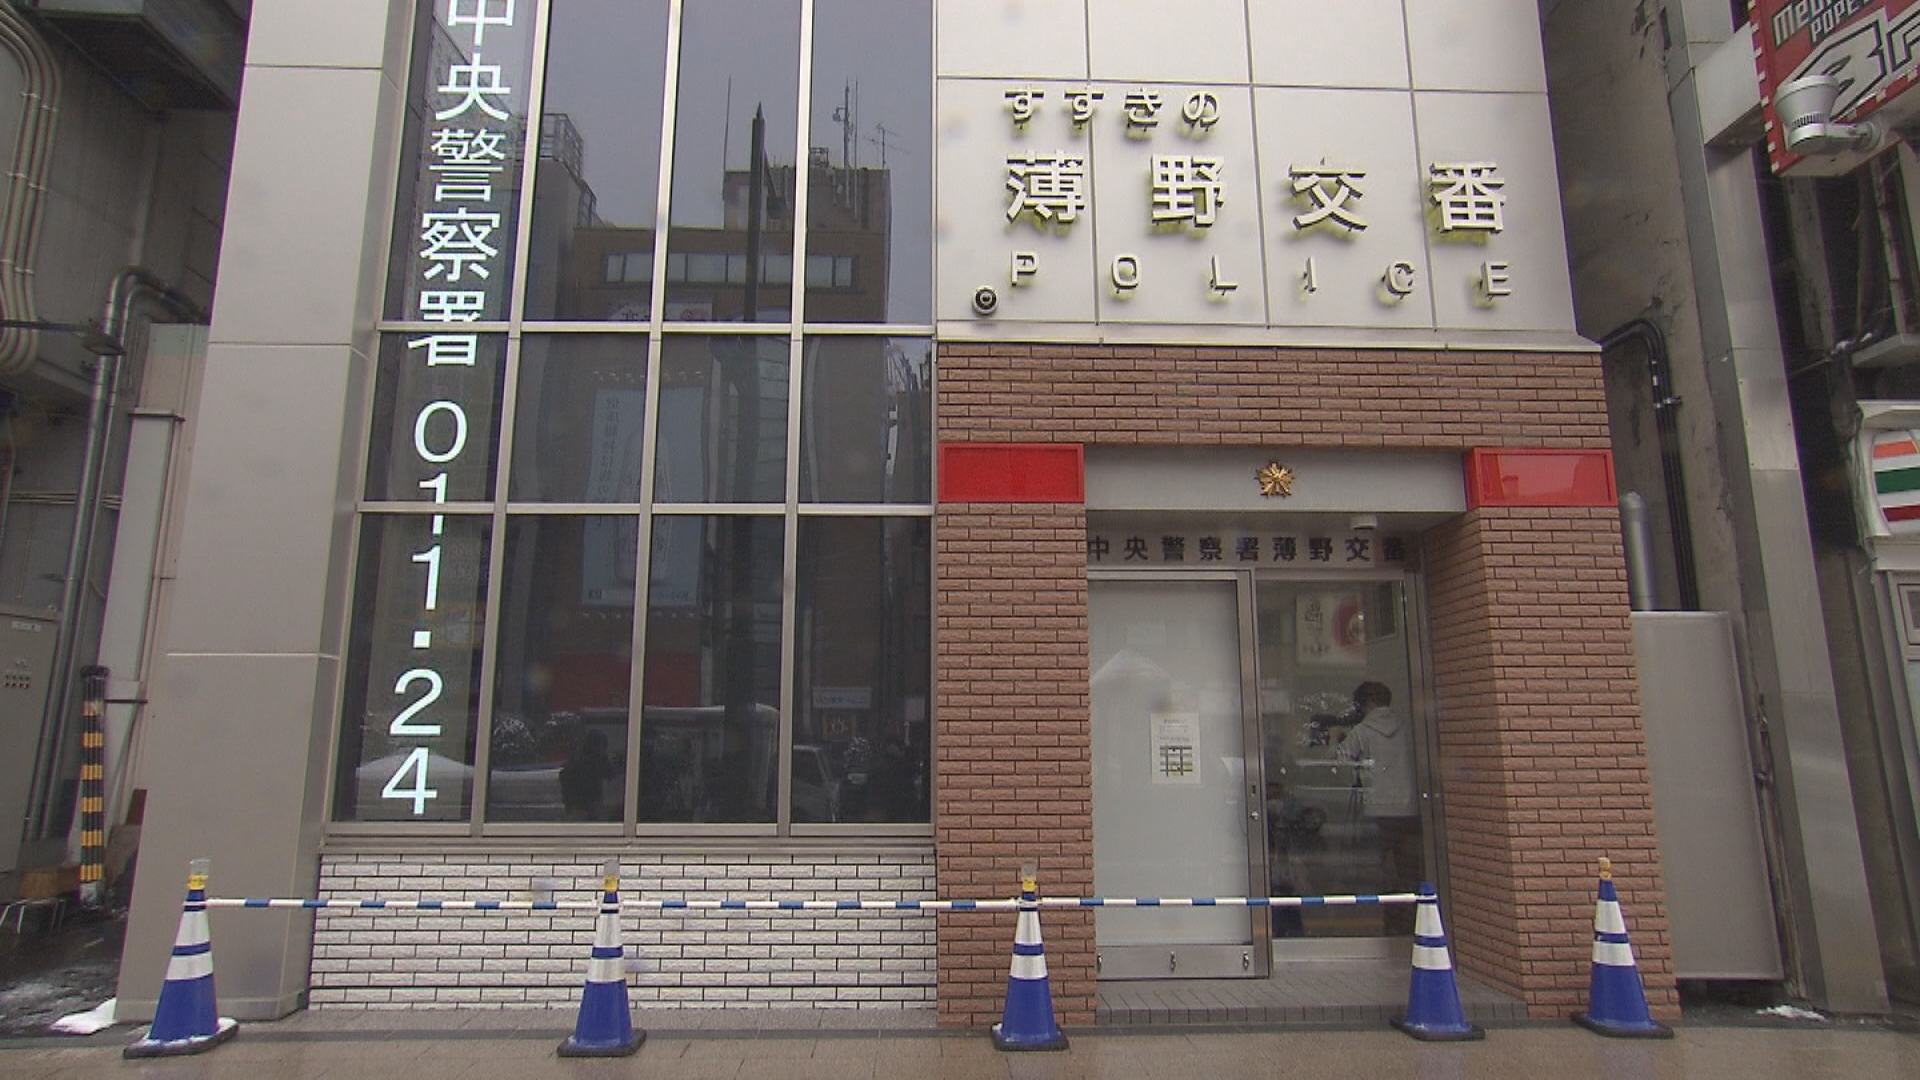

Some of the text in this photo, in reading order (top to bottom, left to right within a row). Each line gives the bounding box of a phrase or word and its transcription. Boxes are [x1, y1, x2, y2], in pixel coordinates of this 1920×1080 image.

[1004, 86, 1220, 130] すすきの
[1005, 150, 1507, 234] 薄野交番
[1010, 250, 1511, 300] POLICE
[1088, 535, 1406, 562] 中央警察署薄野交番
